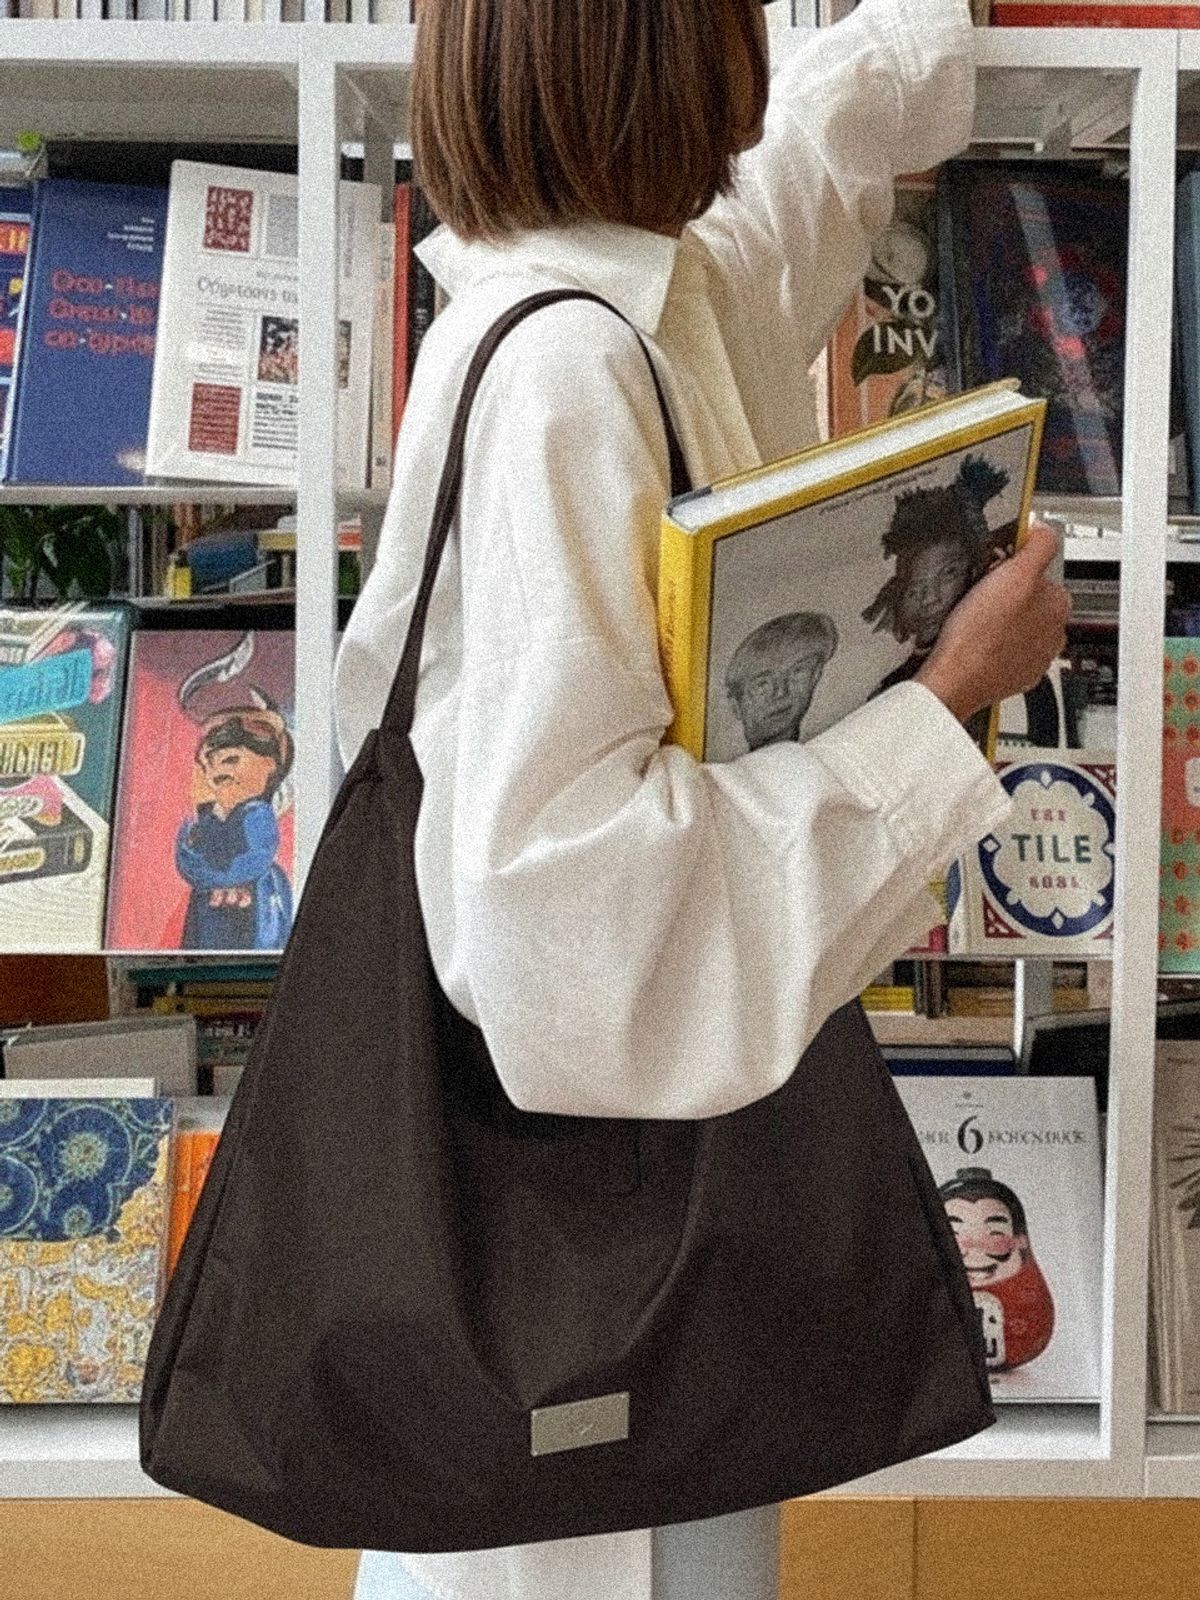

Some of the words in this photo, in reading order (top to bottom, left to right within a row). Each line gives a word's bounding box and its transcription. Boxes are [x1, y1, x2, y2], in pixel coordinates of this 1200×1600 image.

[873, 324, 939, 359] INV
[1011, 834, 1092, 863] TILE
[956, 1115, 984, 1154] 6
